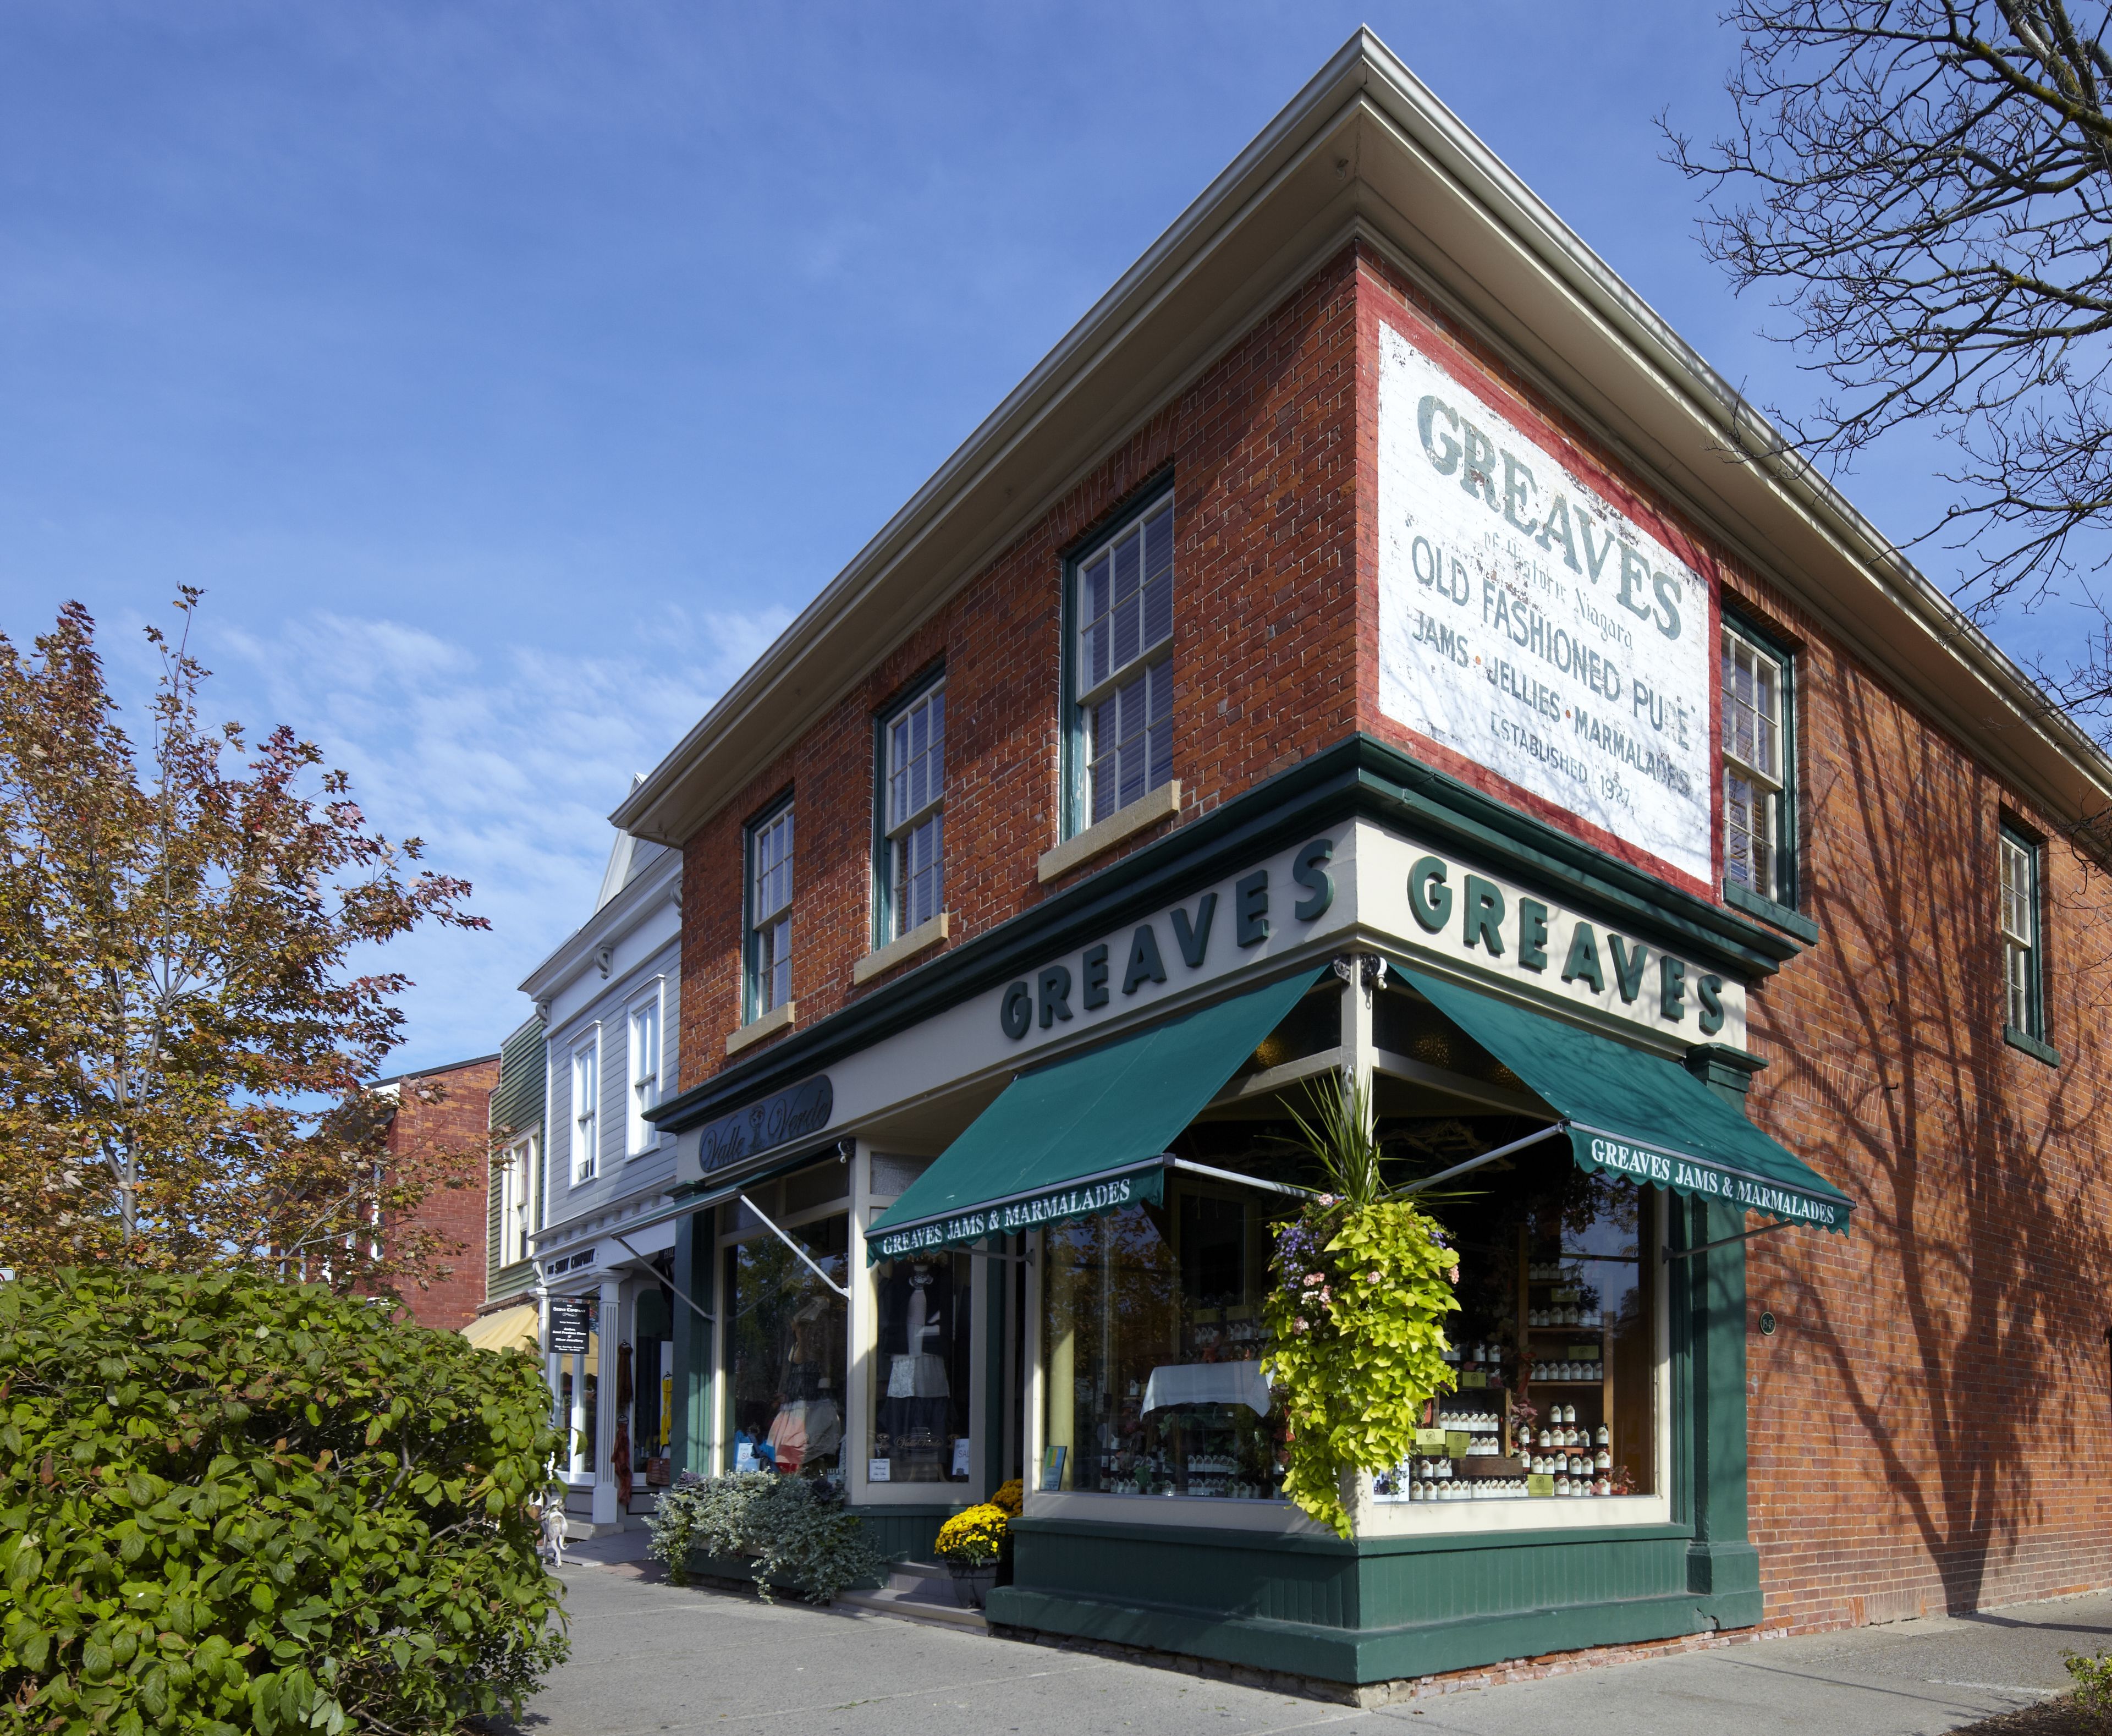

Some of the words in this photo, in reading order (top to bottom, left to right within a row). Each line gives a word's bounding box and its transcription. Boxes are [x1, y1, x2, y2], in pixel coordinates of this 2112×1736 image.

[1417, 394, 1682, 640] GREAVES
[1412, 535, 1470, 606] OLD
[1483, 578, 1620, 702] FASHIONED
[1574, 587, 1633, 651] Niagara
[1412, 607, 1469, 668] JAMS
[1487, 657, 1560, 723] JELLIES
[1575, 706, 1690, 798] MARMALADES
[1491, 711, 1587, 784] ESTABLISHED
[1000, 838, 1334, 1040] GREAVES
[1407, 855, 1724, 1035] GREAVES
[700, 1114, 746, 1169] Valle
[768, 1083, 829, 1140] Verde
[1591, 1138, 1670, 1181] GREAVES
[1675, 1163, 1717, 1193] JAMS
[1722, 1176, 1734, 1198] &
[1737, 1180, 1835, 1224] MARMALADES
[883, 1223, 943, 1255] GREAVES
[947, 1213, 985, 1240] JAMS
[988, 1212, 1000, 1230] &
[1004, 1178, 1131, 1227] MARMALADES
